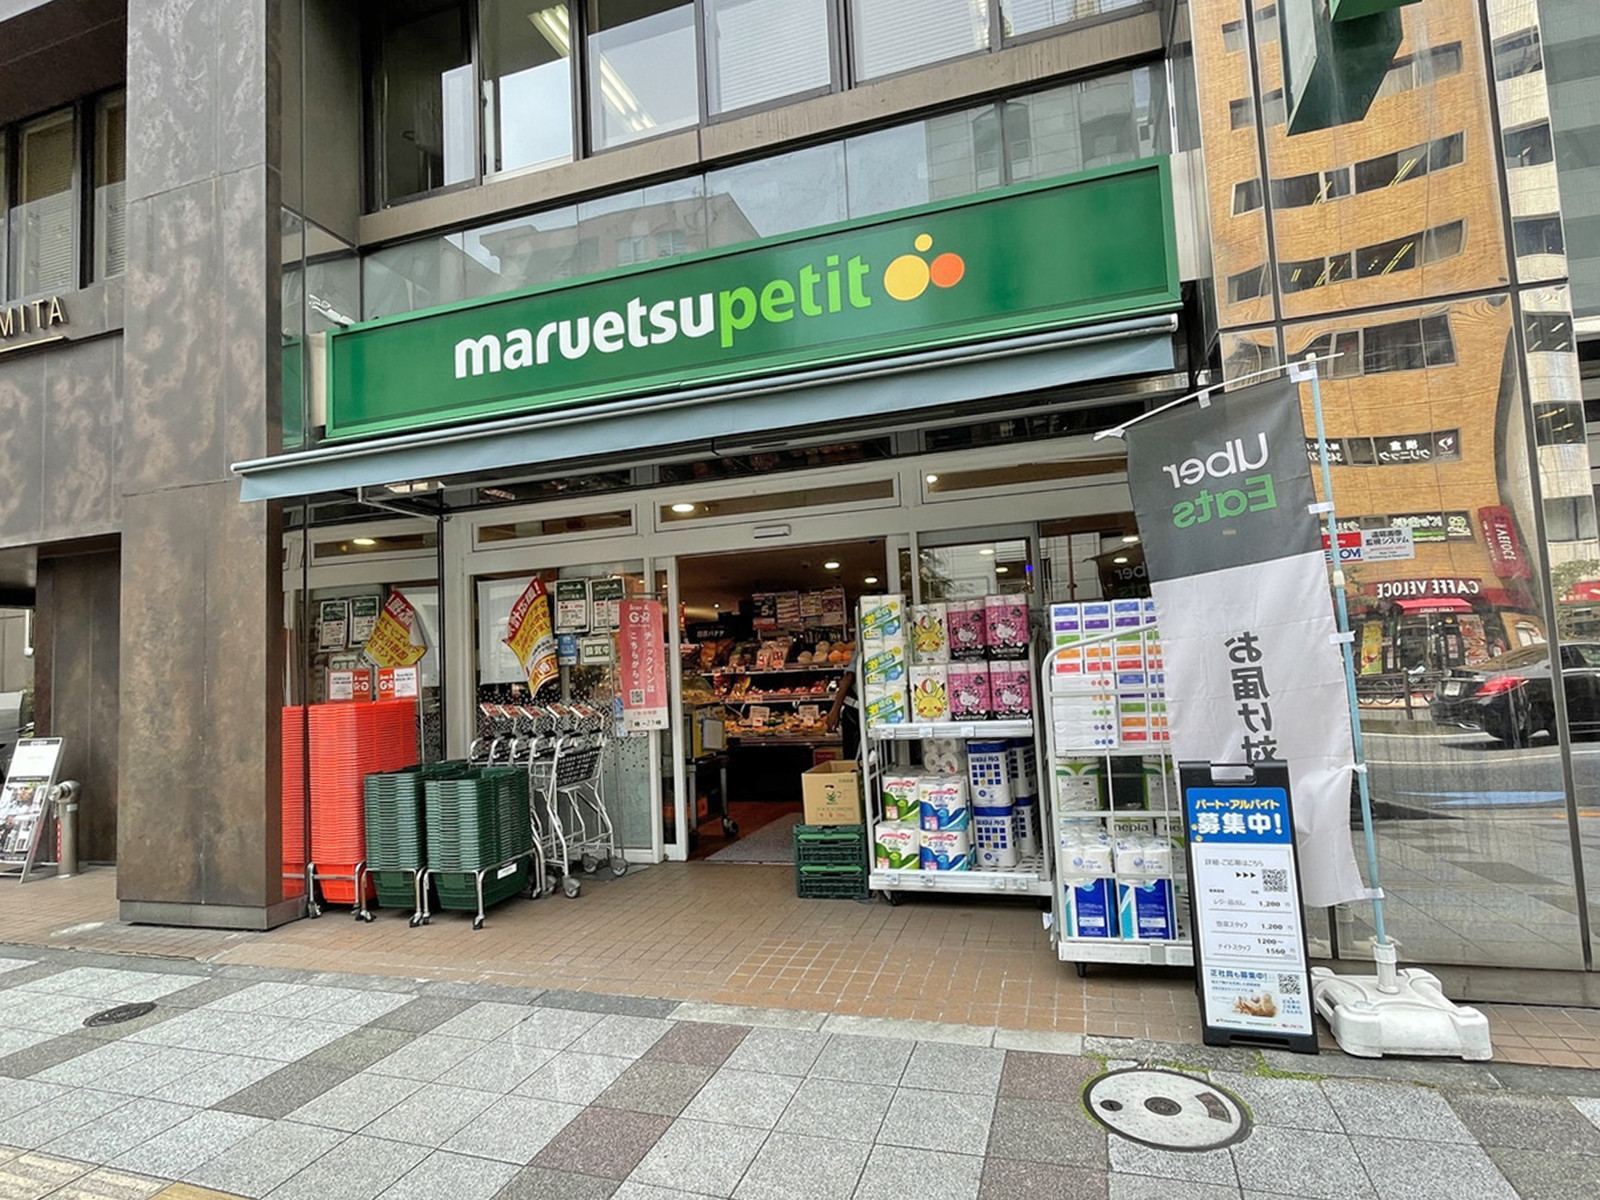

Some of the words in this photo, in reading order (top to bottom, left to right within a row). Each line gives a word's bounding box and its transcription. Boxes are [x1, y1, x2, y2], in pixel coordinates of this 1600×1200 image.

[1195, 799, 1280, 810] パート・アルバイト
[1197, 812, 1283, 835] 募集中!
